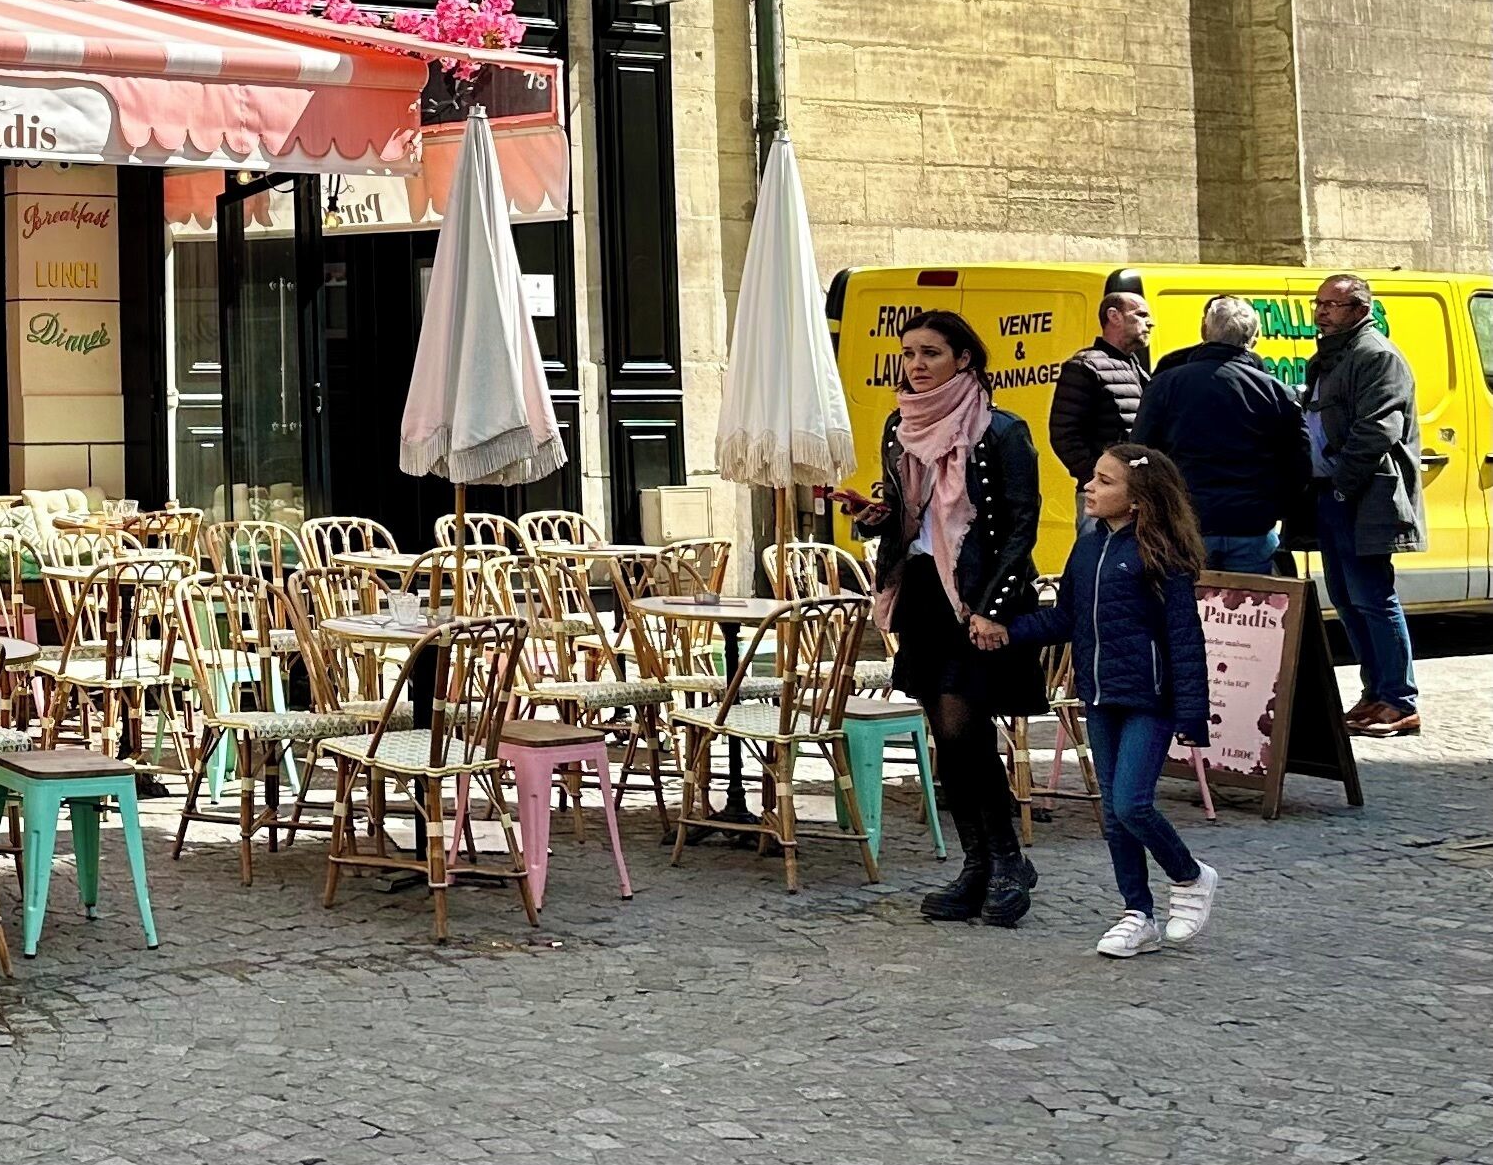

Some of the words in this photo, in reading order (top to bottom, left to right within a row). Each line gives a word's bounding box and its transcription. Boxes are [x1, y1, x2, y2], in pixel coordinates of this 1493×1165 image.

[523, 70, 548, 90] 78
[22, 202, 111, 240] Breakfast
[35, 261, 99, 289] LUNCH
[26, 312, 111, 356] Dinner
[999, 312, 1053, 337] VENTE
[1014, 341, 1026, 361] &
[1204, 605, 1277, 630] Paradis
